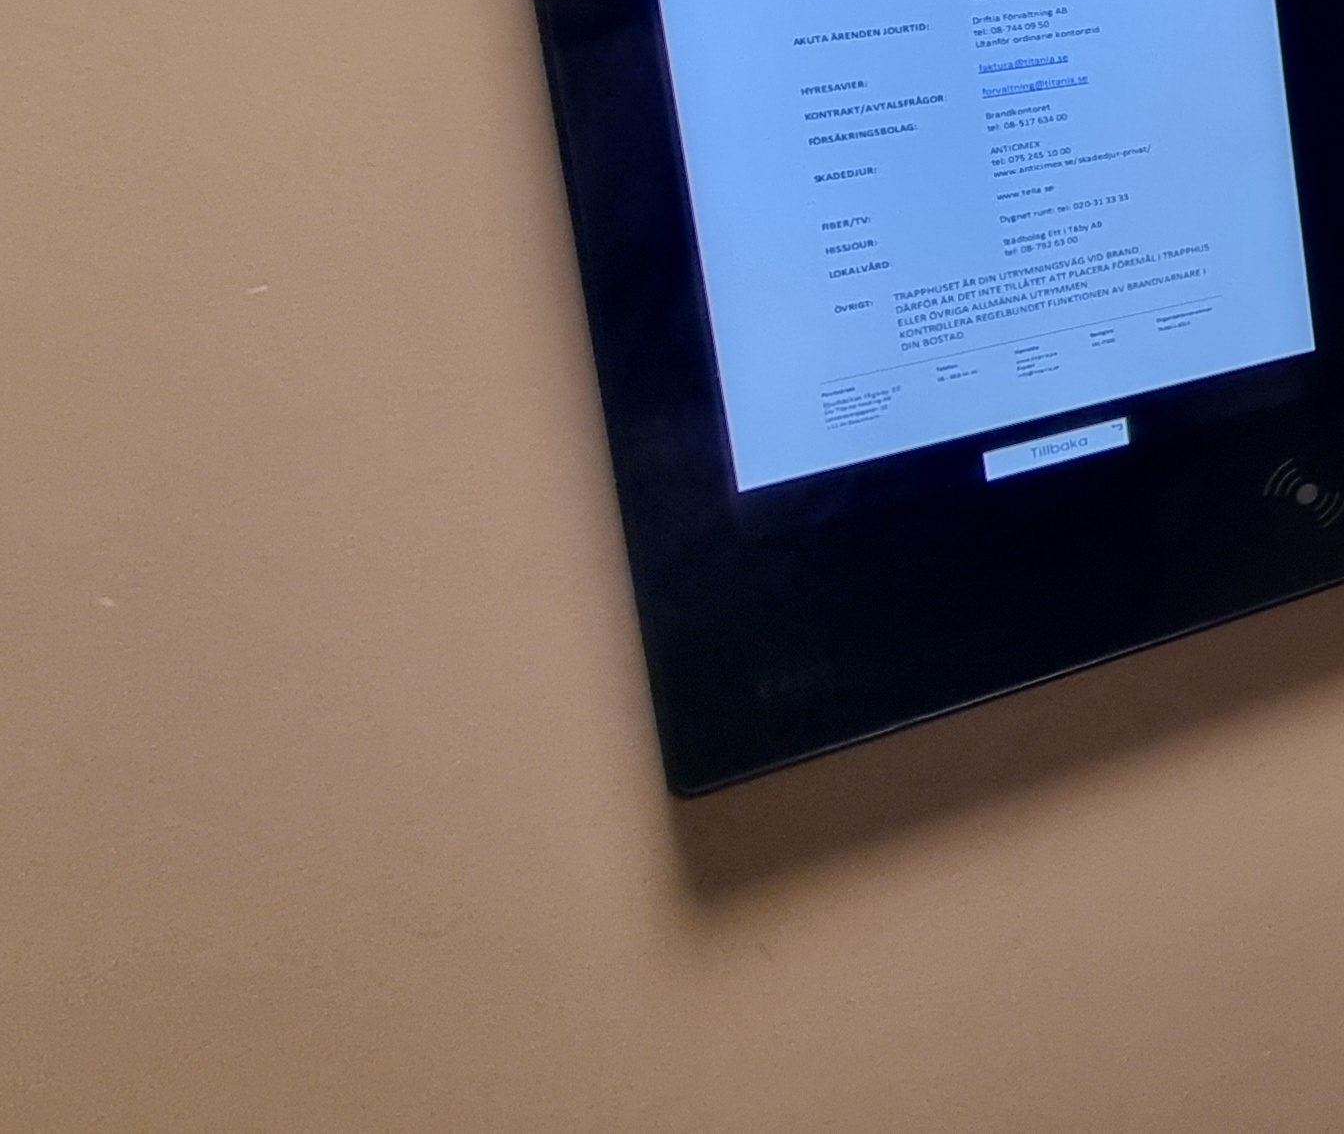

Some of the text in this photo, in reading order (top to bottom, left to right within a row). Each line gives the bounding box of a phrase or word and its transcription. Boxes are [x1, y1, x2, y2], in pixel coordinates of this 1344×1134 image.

[972, 6, 1068, 25] Driftia Förvaltning AB
[793, 34, 829, 46] AKUTA
[830, 28, 881, 42] ÄRENDEN
[989, 23, 1023, 35] 08-744
[1024, 21, 1037, 31] 09
[1037, 20, 1050, 30] 50
[975, 26, 1101, 49] Utanför ordinarie kontorstid
[985, 104, 1051, 120] Brandkontoret
[1003, 117, 1036, 130] 08-517
[1037, 115, 1054, 125] 634
[1055, 113, 1068, 122] 00
[990, 140, 1041, 155] ANTICIMEX
[1007, 153, 1026, 164] 075
[1027, 151, 1045, 161] 245
[1047, 148, 1059, 158] 10
[1059, 146, 1072, 156] 00
[999, 211, 1031, 224] Dygnet
[1072, 198, 1104, 211] 020-31
[1105, 195, 1117, 204] 33
[1118, 193, 1130, 202] 33
[1090, 220, 1103, 230] AB
[1066, 235, 1079, 245] 00
[892, 246, 1139, 301] TRAPPHUSET ÄR DIN UTRYMNINGSVÄG VID BRAND
[940, 294, 956, 305] ÄR
[957, 290, 977, 302] DET
[978, 284, 1002, 297] INTE
[1003, 275, 1047, 292] TILLÅTET
[1048, 271, 1067, 283] ATT
[1068, 263, 1110, 279] PLACERA
[1111, 253, 1156, 270] FÖREMÅL
[1162, 243, 1210, 259] TRAPPHUS
[897, 281, 1088, 328] ELLER ÖVRIGA ALLMÄNNA UTRYMMEN
[899, 316, 974, 339] KONTROLLERA
[975, 300, 1046, 323] REGELBUNDET
[1047, 288, 1110, 308] FUNKTIONEN
[1111, 285, 1125, 294] AV
[900, 331, 965, 352] DIN BOSTAD
[1030, 435, 1089, 461] Tillbaka
